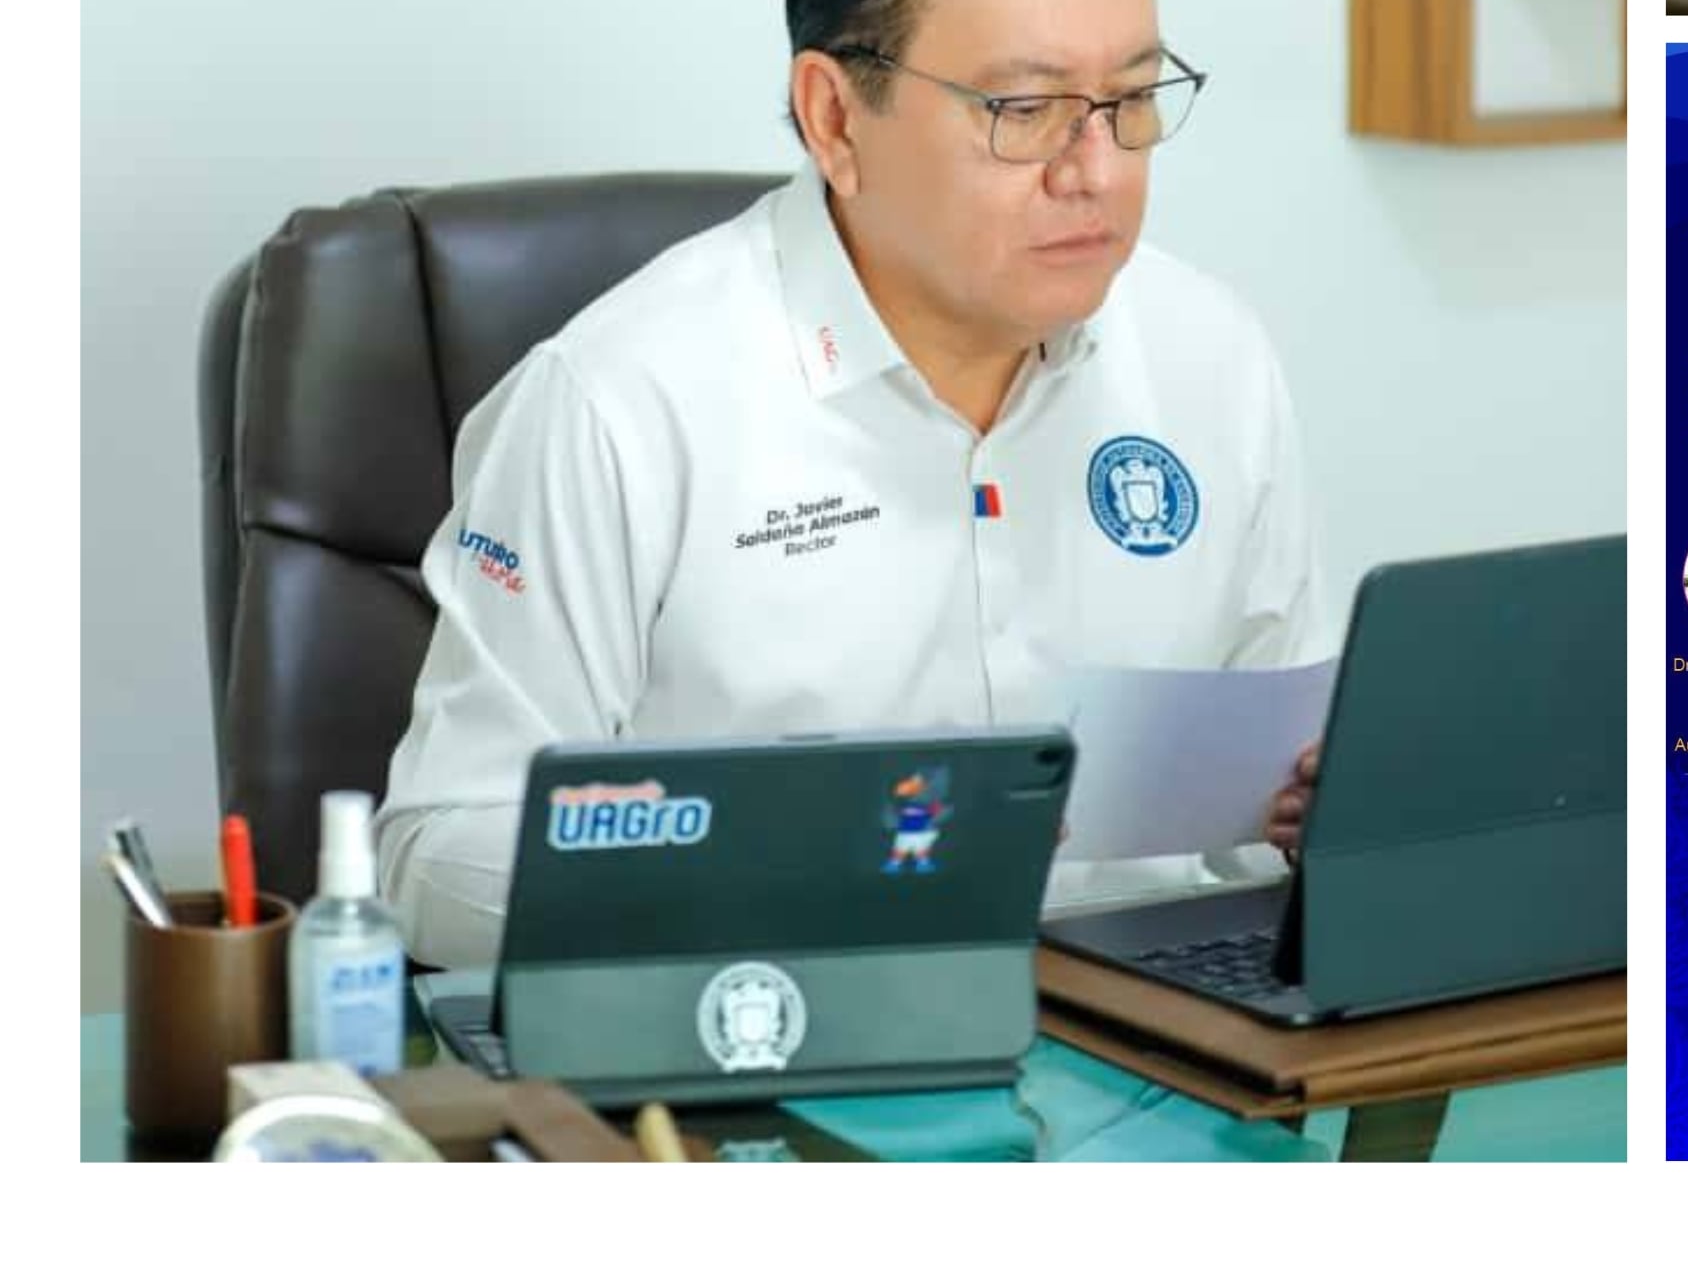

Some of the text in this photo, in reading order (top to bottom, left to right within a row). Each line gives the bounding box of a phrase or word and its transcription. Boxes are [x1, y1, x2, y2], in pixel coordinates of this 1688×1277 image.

[766, 495, 844, 526] Dr. Javier
[734, 519, 806, 550] Saldaña
[784, 533, 839, 557] Rector
[557, 799, 703, 844] UAGro
